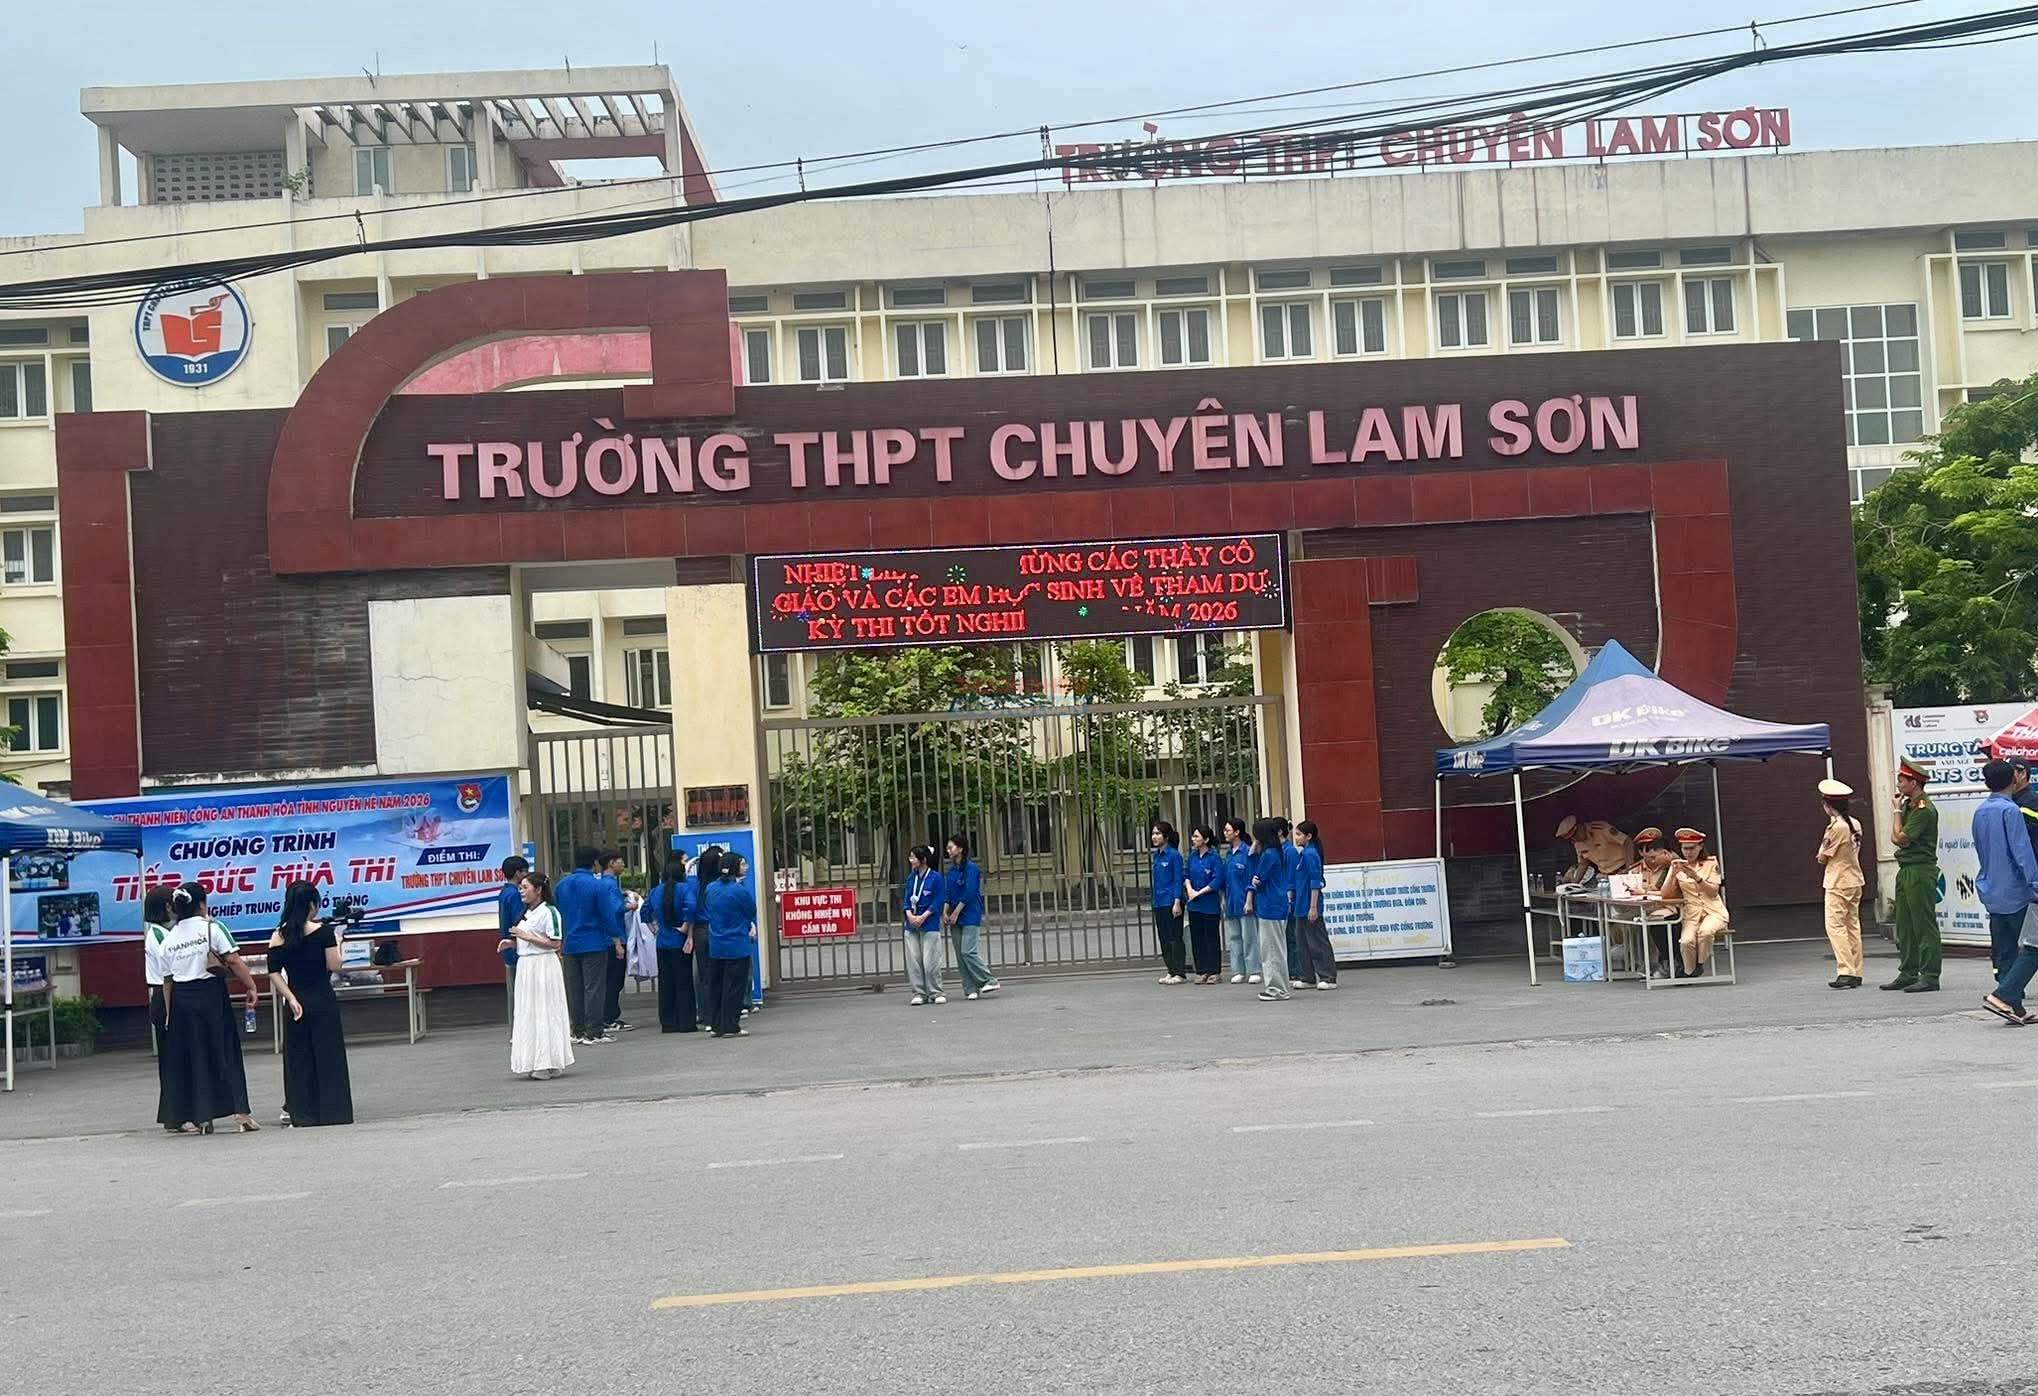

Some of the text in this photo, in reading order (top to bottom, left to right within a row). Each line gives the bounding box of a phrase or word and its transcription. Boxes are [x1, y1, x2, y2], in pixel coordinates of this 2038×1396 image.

[1380, 112, 1564, 167] CHUYÊN
[1586, 114, 1680, 157] LAM
[1698, 106, 1791, 150] SƠN
[183, 363, 208, 374] 1931
[427, 394, 1640, 500] TRƯỜNG THPT CHUYÊN LAM SƠN
[1087, 545, 1138, 571] CÁC
[1144, 541, 1214, 569] THẦY
[1219, 538, 1255, 565] CÔ
[773, 586, 837, 613] GIÁO
[842, 583, 881, 609] VÀ
[884, 582, 937, 608] CÁC
[942, 585, 982, 607] EM
[1047, 579, 1105, 601] SINH
[1110, 572, 1145, 598] VỀ
[1150, 573, 1225, 597] THAM
[1229, 568, 1269, 595] DỰ
[808, 613, 845, 640] KỲ
[851, 616, 896, 638] THI
[899, 609, 951, 635] TỐT
[1186, 600, 1238, 621] 2026
[1591, 706, 1633, 727] DK
[1608, 738, 1660, 759] DK
[1905, 737, 1984, 758] TRUNG TÂ
[1928, 767, 1962, 783] LTS
[127, 812, 162, 828] THANH
[163, 807, 189, 826] NIÊN
[189, 805, 218, 823] CÔNG
[219, 806, 236, 821] AN
[237, 803, 271, 819] THANH
[379, 791, 401, 809] NĂM
[401, 792, 431, 808] 2026
[169, 828, 337, 861] CHƯƠNG TRÌNH
[459, 851, 481, 861] THI:
[196, 861, 257, 895] SỨC
[270, 855, 334, 890] MÙA
[348, 857, 397, 884] THI
[430, 872, 447, 887] THPT
[478, 868, 492, 883] LAM
[494, 867, 508, 883] SƠ
[245, 901, 281, 915] TRUNG
[794, 896, 811, 906] KHU
[829, 894, 842, 904] THI
[785, 907, 852, 921] KHÔNG NHIỆM VỤ
[801, 921, 838, 934] CẤM VÀO
